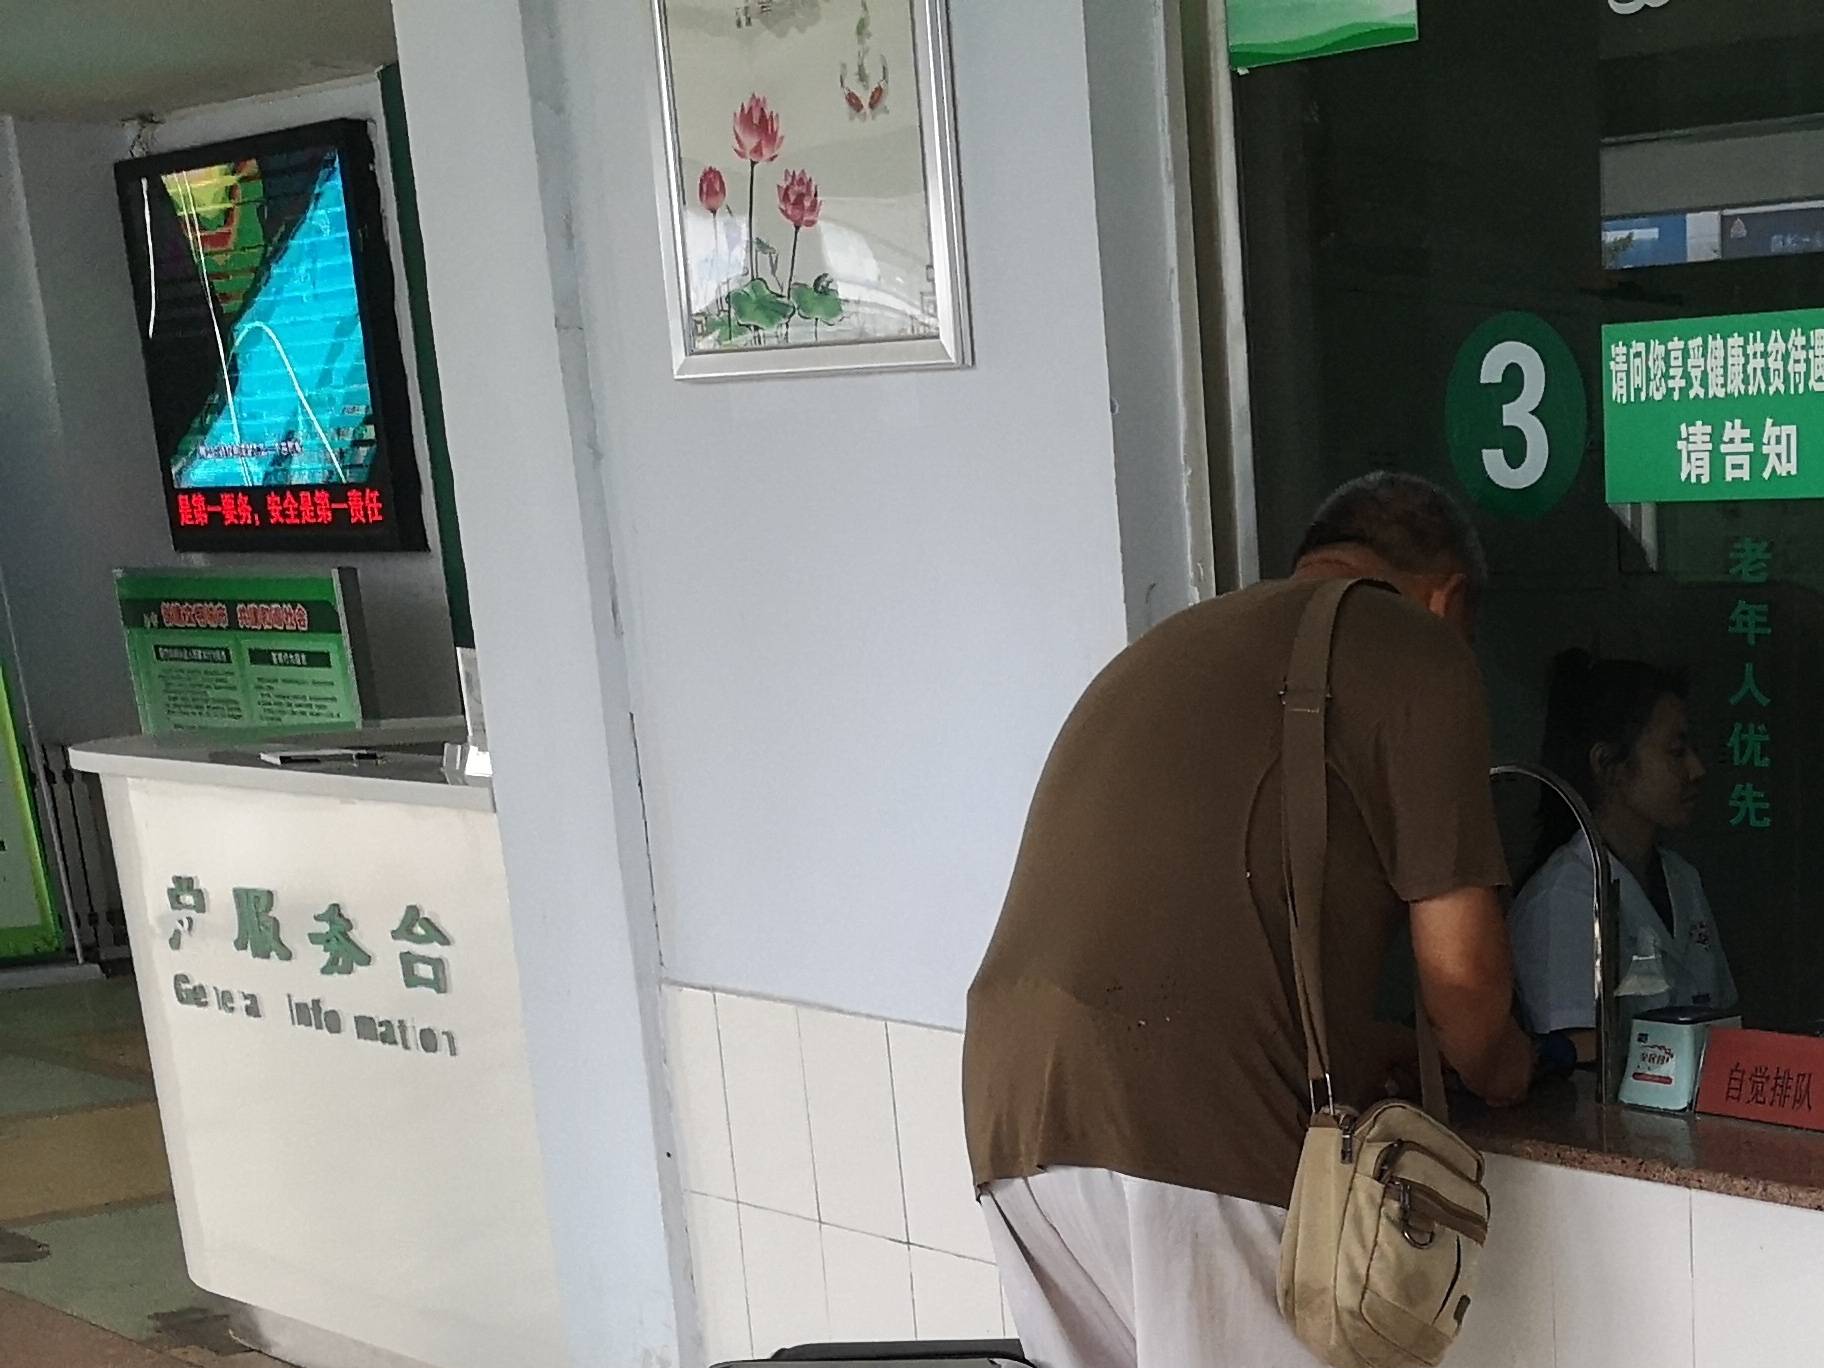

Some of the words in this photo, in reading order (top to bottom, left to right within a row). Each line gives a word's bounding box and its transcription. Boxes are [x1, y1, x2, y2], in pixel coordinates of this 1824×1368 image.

[1480, 341, 1548, 489] 3
[1677, 418, 1798, 484] 请告知
[1727, 537, 1772, 828] 老年人优先
[1725, 1062, 1812, 1111] 自觉排队
